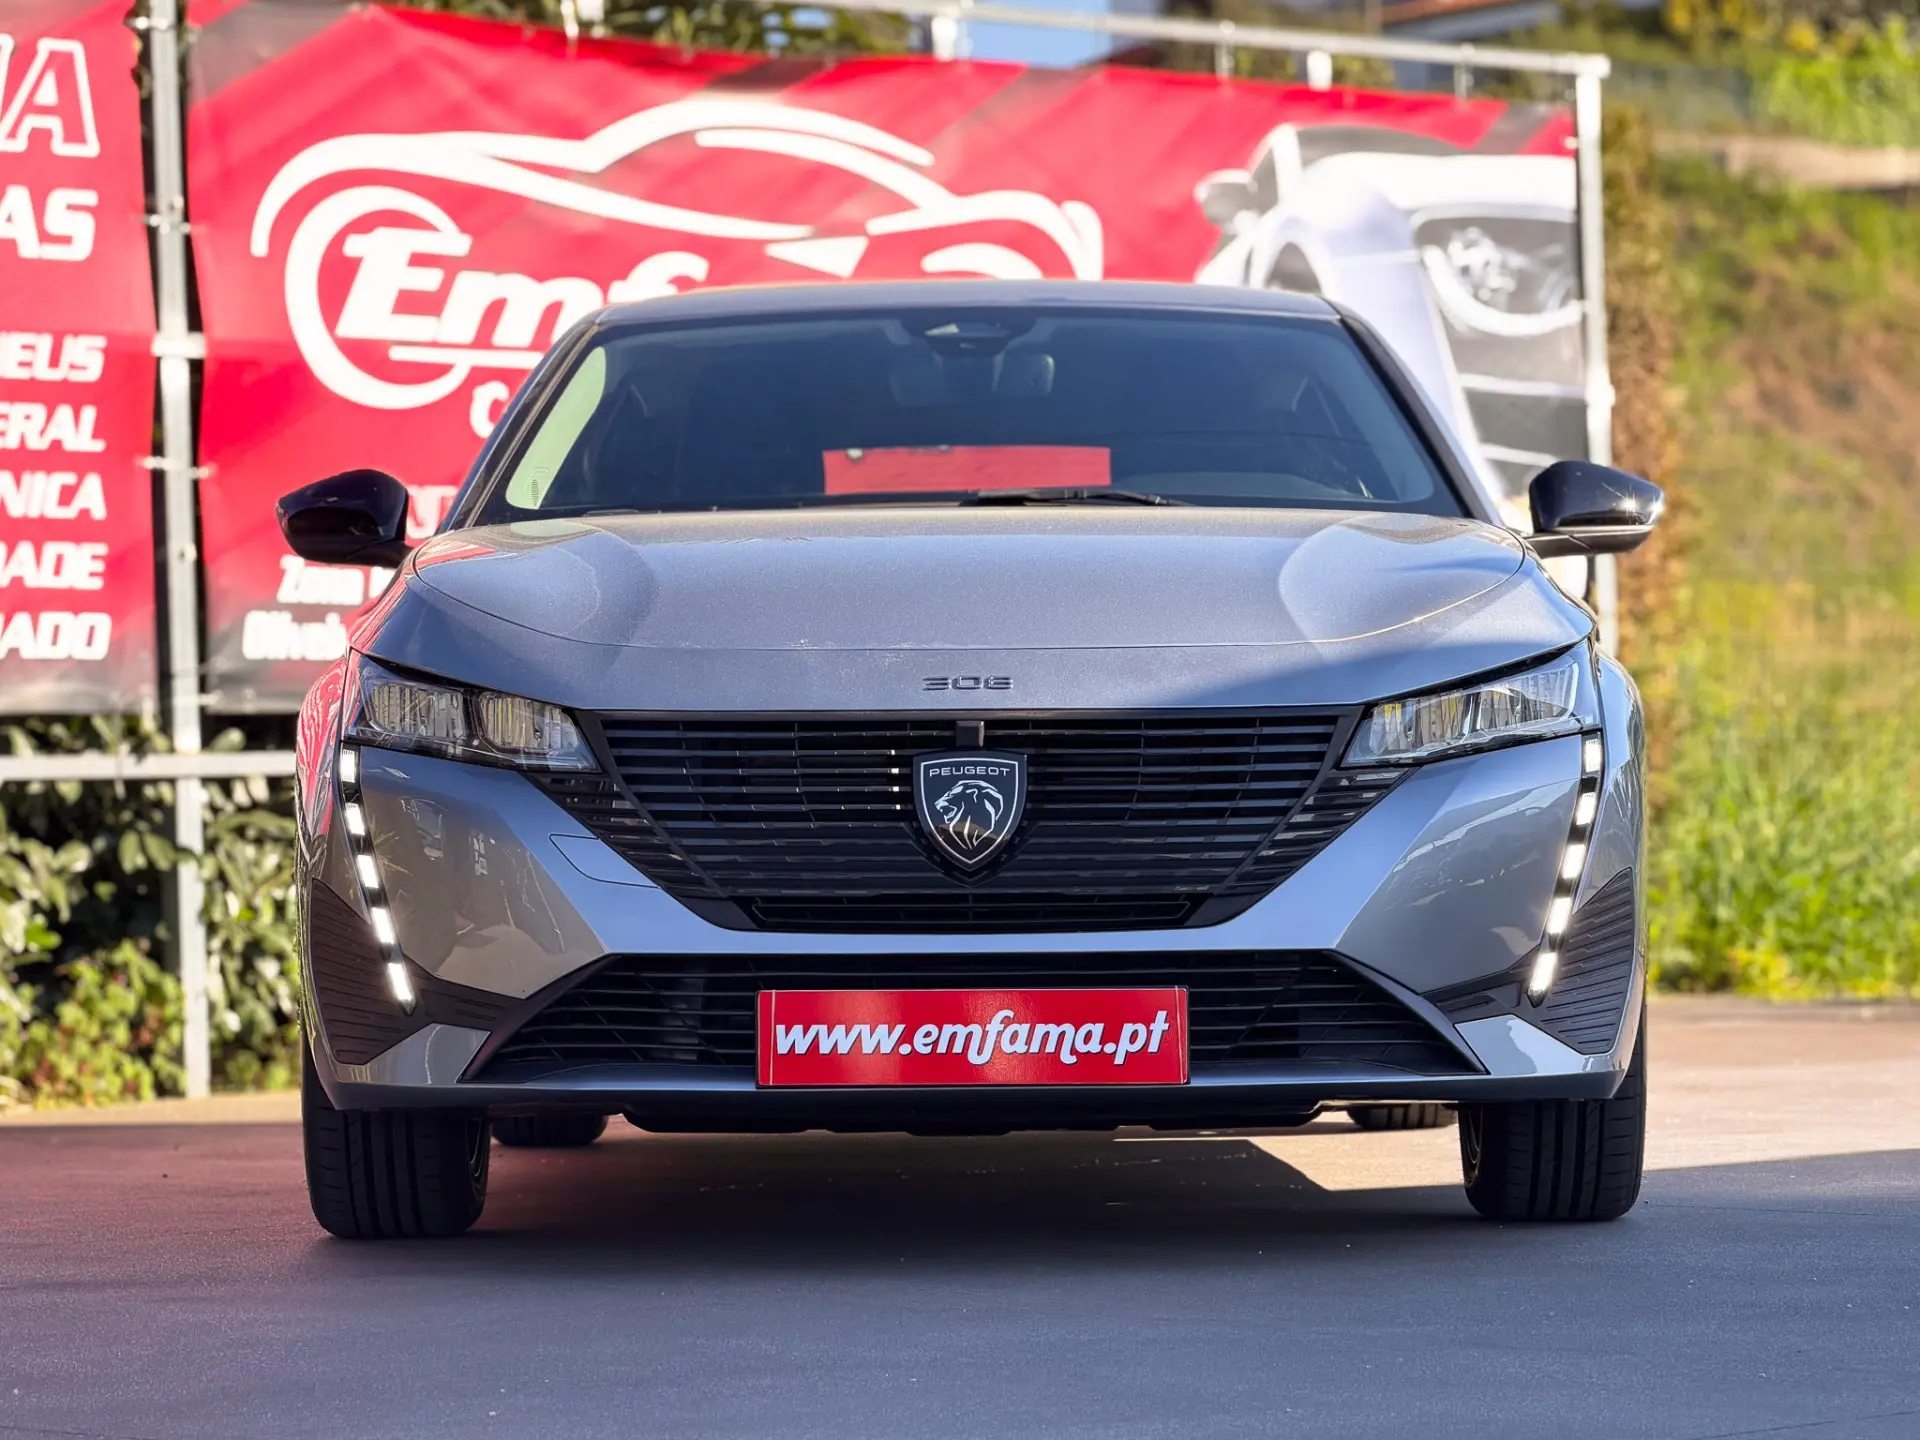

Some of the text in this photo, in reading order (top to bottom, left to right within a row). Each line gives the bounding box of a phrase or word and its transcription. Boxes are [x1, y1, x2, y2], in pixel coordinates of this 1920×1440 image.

[0, 33, 100, 158] A
[0, 539, 109, 591] ADE
[0, 610, 113, 661] ADO
[922, 675, 1013, 691] 308
[929, 766, 1010, 777] PEUGEOT
[775, 1009, 1170, 1066] www.emfama.pt
